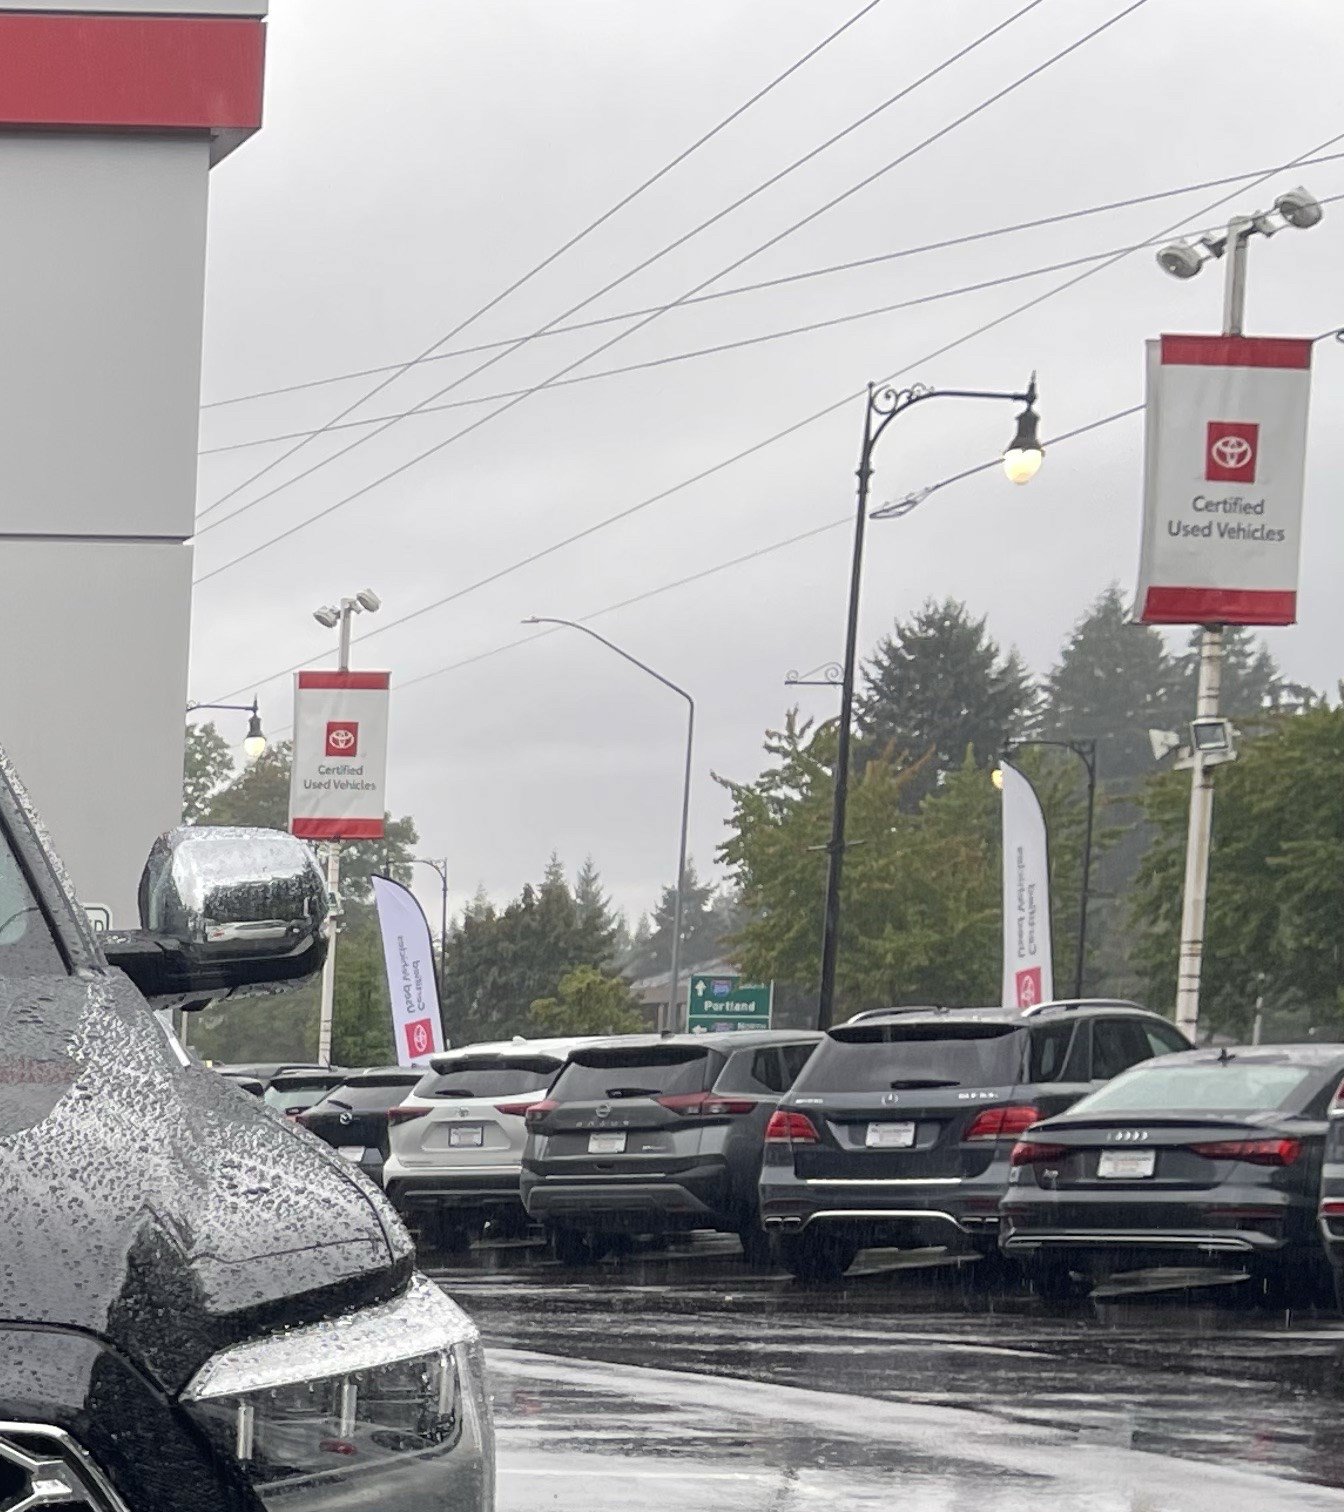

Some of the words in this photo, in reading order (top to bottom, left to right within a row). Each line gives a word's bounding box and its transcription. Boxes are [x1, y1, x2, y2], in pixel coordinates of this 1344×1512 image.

[1192, 494, 1264, 515] Certified
[1167, 519, 1213, 538] Used
[1216, 521, 1286, 542] Vehicles
[317, 764, 364, 776] Certified
[303, 779, 331, 790] Used
[333, 779, 377, 791] Vehicles
[704, 1000, 756, 1012] Portland
